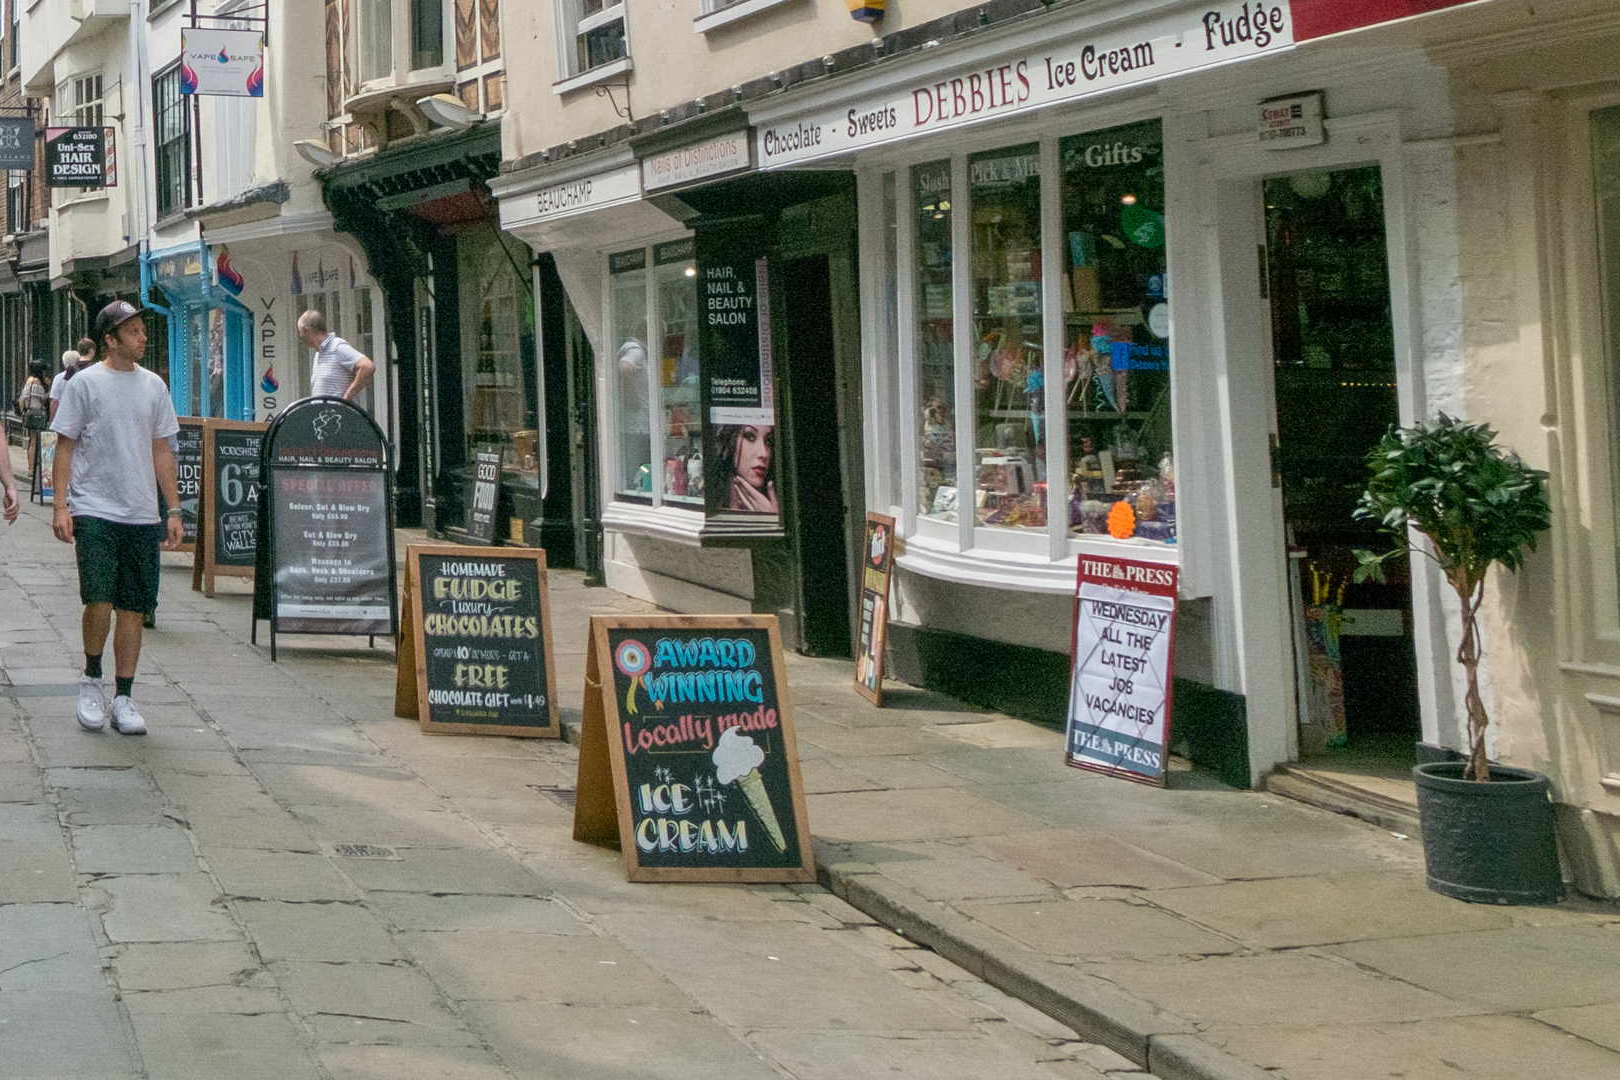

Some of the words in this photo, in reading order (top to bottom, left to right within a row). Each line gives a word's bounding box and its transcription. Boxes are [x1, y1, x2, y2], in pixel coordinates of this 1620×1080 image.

[764, 123, 822, 156] Chocolate
[847, 104, 897, 137] Sweets
[912, 59, 1032, 127] DEBBIES
[1045, 56, 1076, 90] Ice
[1081, 39, 1155, 81] Cream
[1203, 2, 1285, 51] Fudge
[58, 143, 95, 151] Uni-Sex
[61, 152, 92, 163] HAIR
[651, 156, 671, 175] Nails
[674, 154, 682, 169] of
[684, 139, 737, 167] Distinctions
[1085, 142, 1142, 167] Gifts
[53, 163, 101, 175] DESIGN
[970, 160, 998, 184] Pick
[1002, 166, 1011, 179] &
[920, 171, 949, 194] Slush
[537, 181, 593, 213] BEAUCHAMP
[707, 266, 737, 280] HAIR,
[707, 282, 733, 294] NAIL
[737, 281, 745, 293] &
[708, 297, 752, 309] BEAUTY
[260, 297, 276, 358] VAPE
[708, 312, 747, 325] SALON
[246, 438, 260, 447] THE
[221, 464, 243, 506] 6
[339, 480, 376, 492] OFFER
[289, 503, 314, 511] Colour,
[316, 503, 329, 511] Cut
[357, 505, 370, 513] Dry
[227, 540, 257, 551] WALLS
[231, 531, 255, 540] CITY
[344, 532, 357, 540] Dry
[311, 558, 342, 566] Massage
[338, 567, 375, 576] Shoulders
[440, 562, 506, 577] HOMEMADE
[1082, 560, 1112, 577] THE
[1126, 565, 1173, 586] PRESS
[434, 578, 523, 601] FUDGE
[424, 613, 539, 639] CHOCOLATES
[1092, 601, 1167, 630] WEDNESDAY
[1101, 627, 1123, 645] ALL
[1126, 631, 1152, 651] THE
[508, 650, 522, 660] GET
[654, 637, 756, 668] AWARD
[1101, 650, 1147, 674] LATEST
[454, 663, 510, 689] FREE
[644, 670, 764, 703] WINNING
[1109, 678, 1133, 695] JOB
[428, 689, 483, 706] CHOCOLATE
[484, 693, 510, 707] GIFT
[1086, 693, 1154, 725] VACANCIES
[717, 704, 778, 733] made
[1074, 729, 1102, 751] THE
[1113, 740, 1161, 769] PRESS
[638, 783, 694, 815] ICE
[635, 818, 748, 854] CREAM
